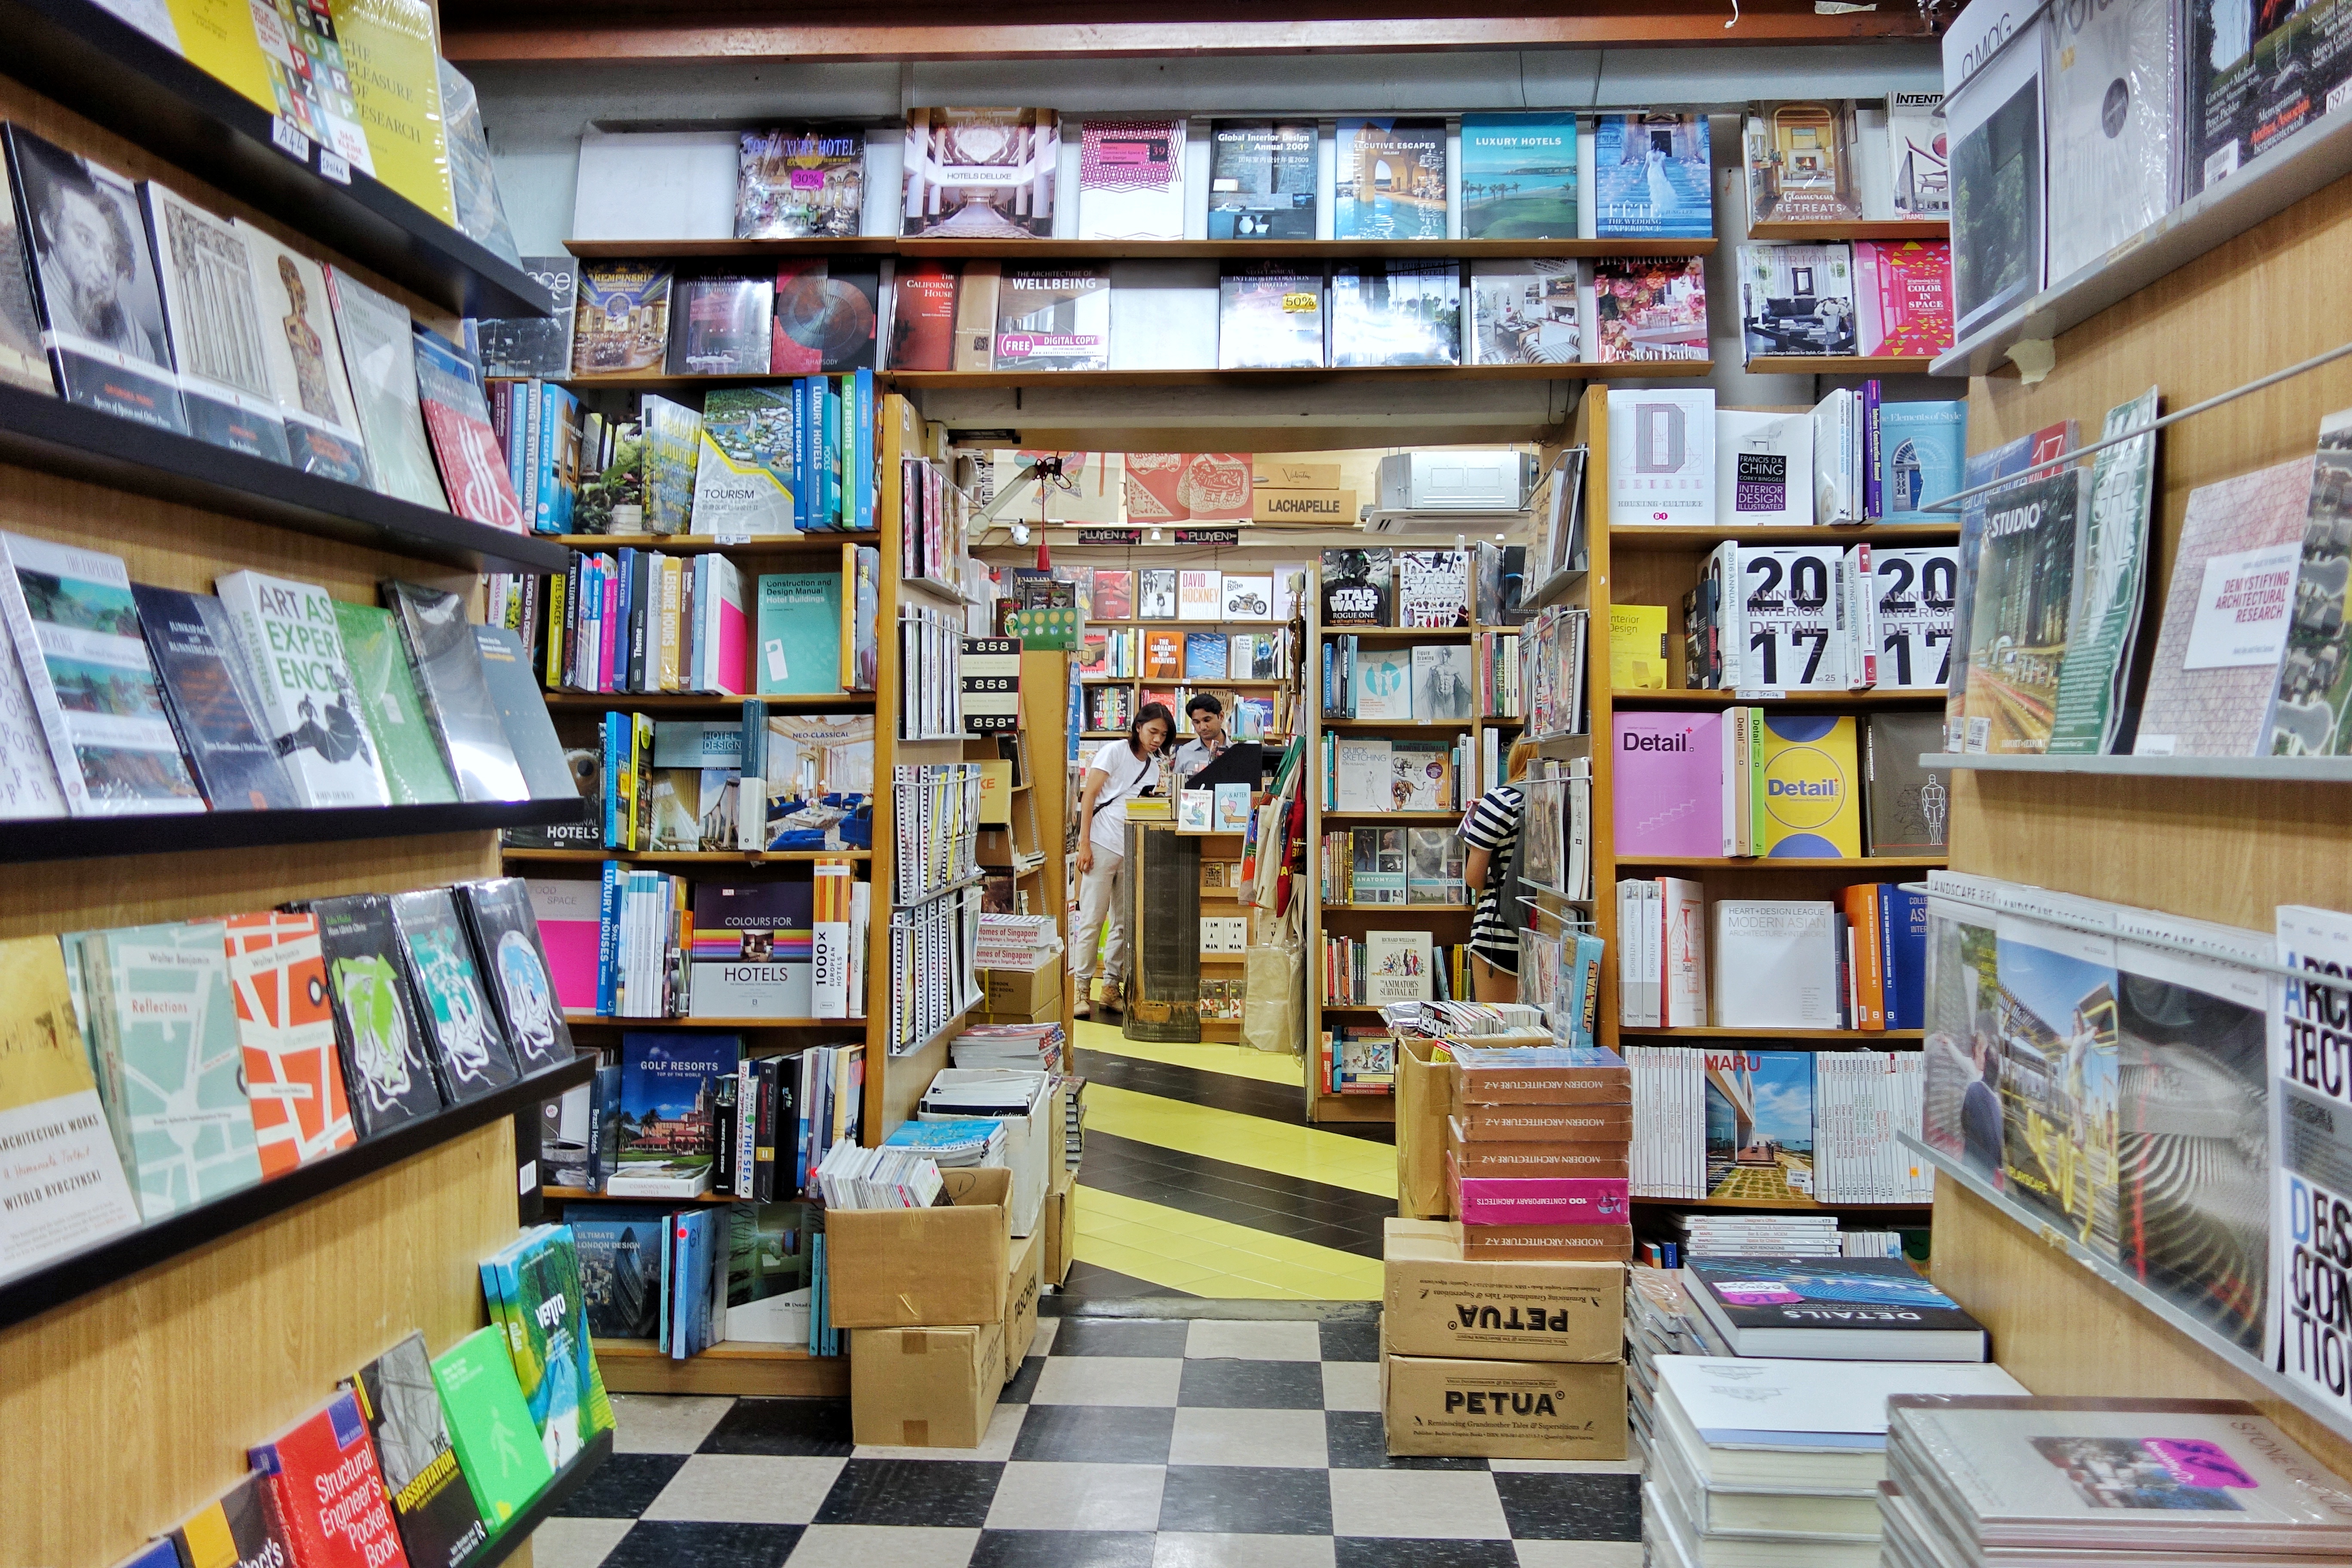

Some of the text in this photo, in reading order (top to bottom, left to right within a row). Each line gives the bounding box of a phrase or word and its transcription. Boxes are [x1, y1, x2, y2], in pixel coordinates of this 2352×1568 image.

[348, 61, 414, 103] PLEASURE
[2328, 87, 2346, 112] 097
[1218, 133, 1309, 143] Global Interior Design
[1476, 137, 1562, 146] LUXURY HOTELS
[1152, 145, 1165, 156] 39
[1254, 143, 1309, 151] Annual 2009
[795, 174, 818, 184] 30%
[1783, 191, 1834, 202] Glamorous
[1776, 204, 1844, 212] RETREATS
[1744, 255, 1845, 266] INTERIORS
[1012, 278, 1096, 290] WELLBEING
[1908, 284, 1942, 293] COLOR
[1285, 297, 1314, 307] 50%
[1005, 340, 1030, 351] FREE
[1044, 336, 1074, 345] DIGITAL
[1075, 336, 1096, 346] COPY
[813, 386, 822, 470] LUXURY HOTELS
[525, 389, 536, 506] LIVING IN STYLE LONDON
[1740, 463, 1784, 475] CHING
[704, 489, 754, 499] TOURISM
[1739, 484, 1783, 494] INTERIOR
[1739, 493, 1783, 504] DESIGN
[1268, 500, 1340, 513] LACHAPELLE
[1992, 504, 2041, 537] STUDIO
[1183, 573, 1205, 587] DAVID
[2224, 570, 2289, 594] DEMYSTIFYING
[767, 588, 793, 596] Design
[1183, 588, 1219, 602] HOCKNEY
[1333, 589, 1375, 600] STAR
[259, 585, 334, 625] ART AS
[1330, 600, 1378, 611] WARS
[2214, 588, 2286, 610] ARCHITECTURAL
[2235, 604, 2283, 623] RESEARCH
[1749, 620, 1828, 635] DETAIL
[703, 741, 741, 749] DESIGN
[1623, 732, 1687, 752] Detail
[1768, 779, 1834, 796] Detail
[547, 826, 599, 839] HOTELS
[1931, 881, 1977, 902] LANDSCAPE
[547, 896, 577, 905] SPACE
[600, 869, 614, 962] LUXURY HOUSES
[725, 917, 792, 926] COLOURS FOR
[1728, 917, 1826, 928] MODERN ASIAN
[978, 928, 1038, 939] Homes of Singapore
[149, 952, 211, 965] Walter Benjamin
[251, 948, 300, 968] Walter Benjamin
[724, 968, 788, 981] HOTELS
[1384, 980, 1418, 988] ANIMATOR'S
[1380, 988, 1407, 996] SURVIVAL
[132, 999, 188, 1014] Reflections
[640, 1061, 719, 1071] GOLF RESORTS
[1704, 1055, 1761, 1072] MARU
[68, 1113, 100, 1135] WORKS
[743, 1160, 751, 1181] SEA
[3, 1170, 102, 1212] WITOLD RYBCZYNSKI
[1457, 1304, 1569, 1332] PETUA
[1782, 1310, 1922, 1320] DETAILS
[1445, 1391, 1557, 1416] PETUA
[1427, 1420, 1466, 1428] Reminiscing
[1538, 1422, 1579, 1430] Superstitions
[314, 1448, 373, 1506] Structural
[396, 1448, 457, 1515] DISSERTATION
[319, 1474, 384, 1540] Engineer's
[348, 1501, 390, 1552] Pocket
